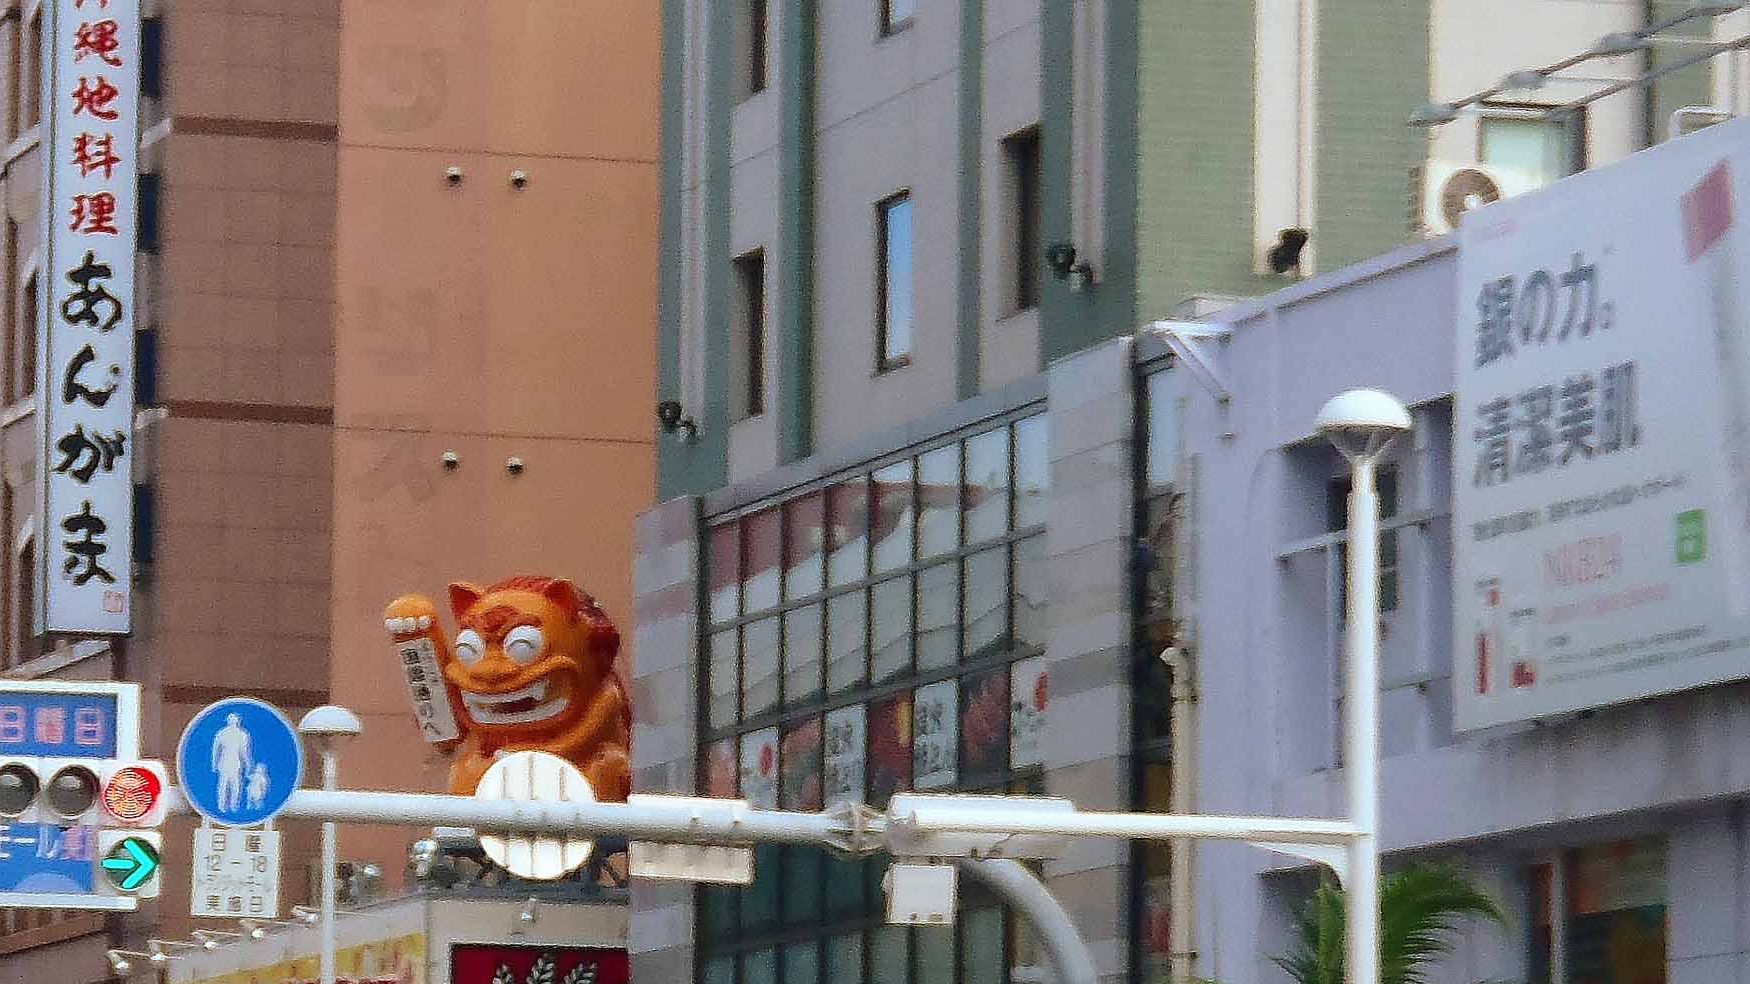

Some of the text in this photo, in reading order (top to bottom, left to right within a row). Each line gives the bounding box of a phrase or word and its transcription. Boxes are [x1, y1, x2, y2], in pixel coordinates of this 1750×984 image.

[69, 0, 123, 235] 縄地料理
[53, 250, 126, 585] あんがま
